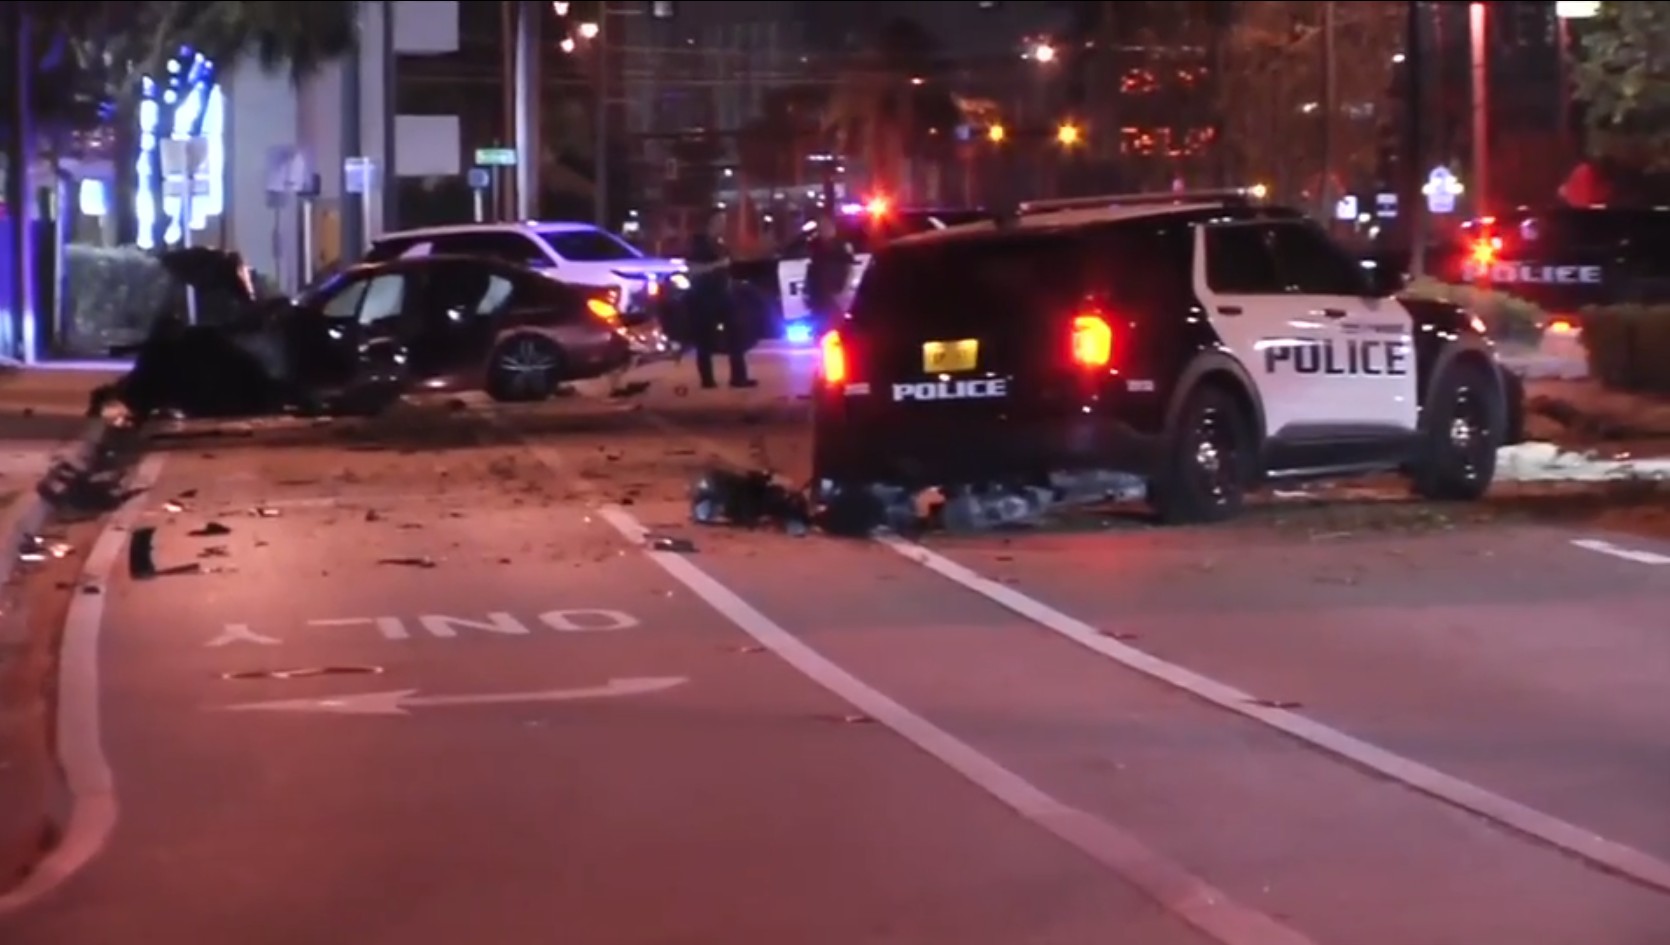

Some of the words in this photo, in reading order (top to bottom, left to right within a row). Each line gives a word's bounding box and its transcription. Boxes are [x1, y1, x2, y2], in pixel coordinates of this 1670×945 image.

[1262, 336, 1407, 375] POLICE
[891, 378, 1008, 402] POLICE
[204, 608, 640, 647] ONLY
